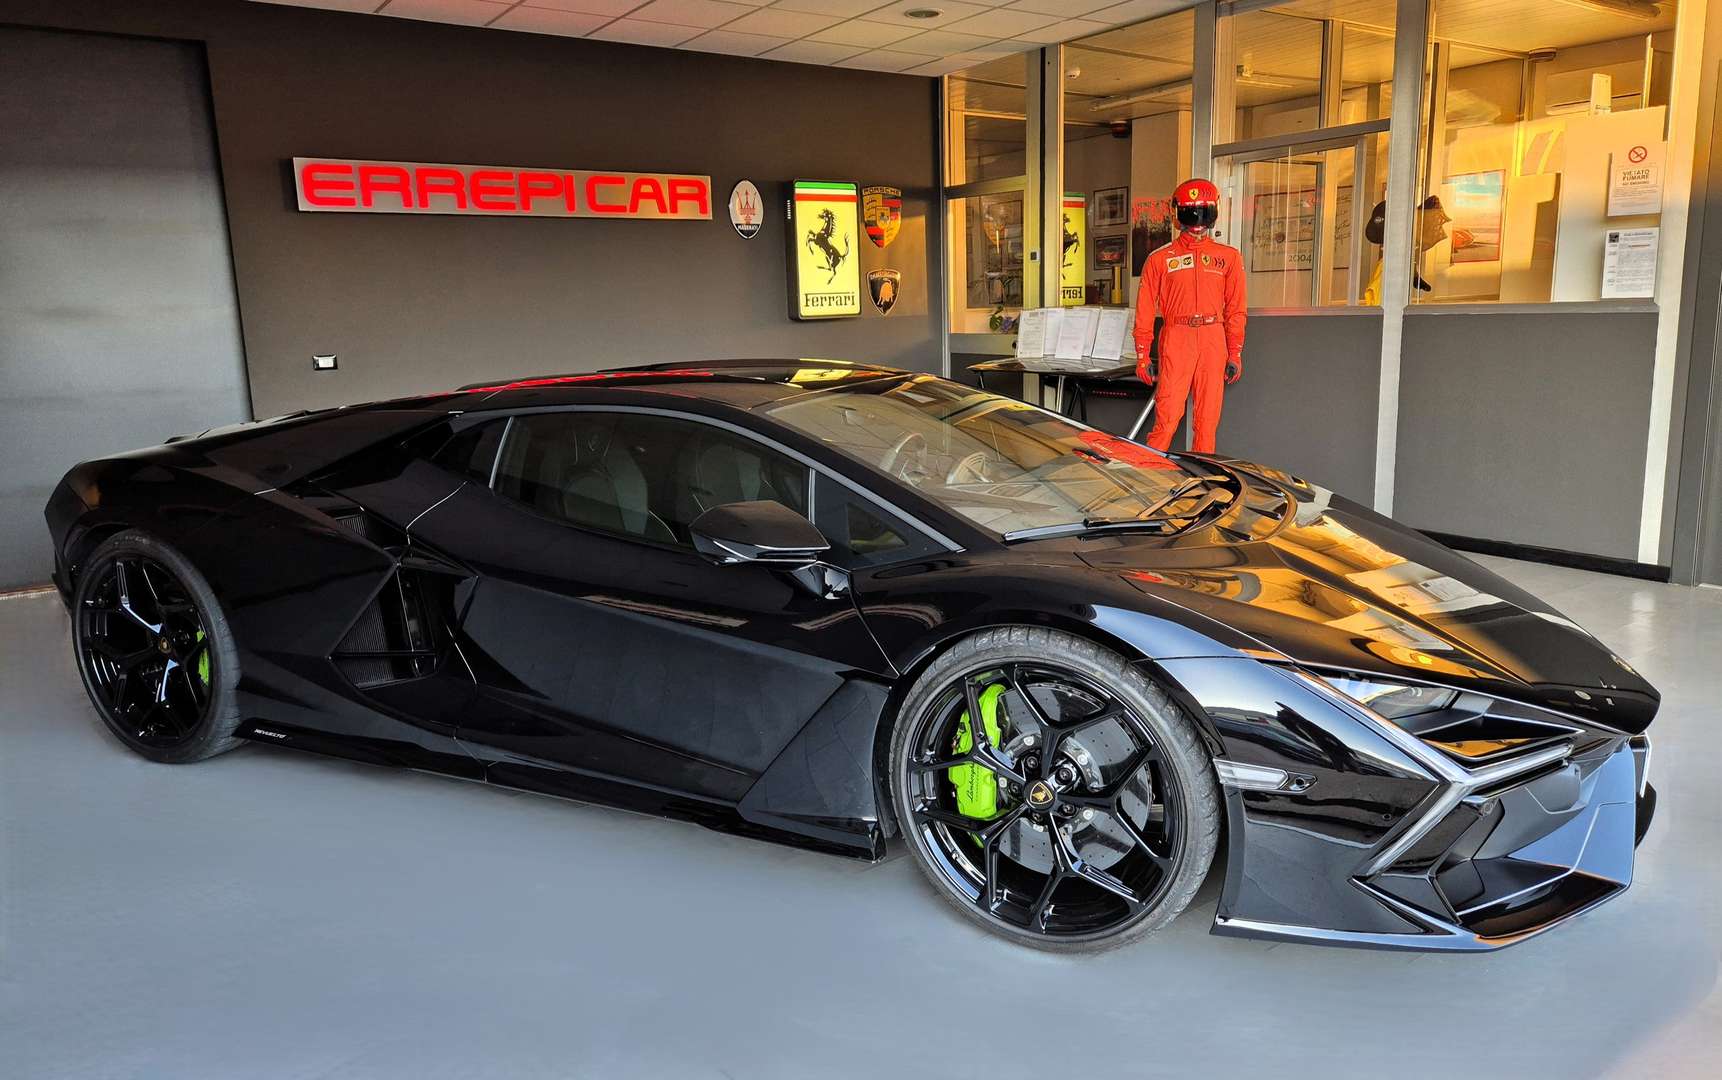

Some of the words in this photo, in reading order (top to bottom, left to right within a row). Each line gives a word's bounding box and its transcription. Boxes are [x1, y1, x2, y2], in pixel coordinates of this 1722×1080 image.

[1622, 169, 1650, 177] VIETATO
[302, 163, 575, 212] ERREPI
[585, 175, 708, 214] CAR
[863, 187, 901, 196] PORSCHE
[1288, 254, 1312, 263] 2004
[804, 291, 856, 307] Ferrari
